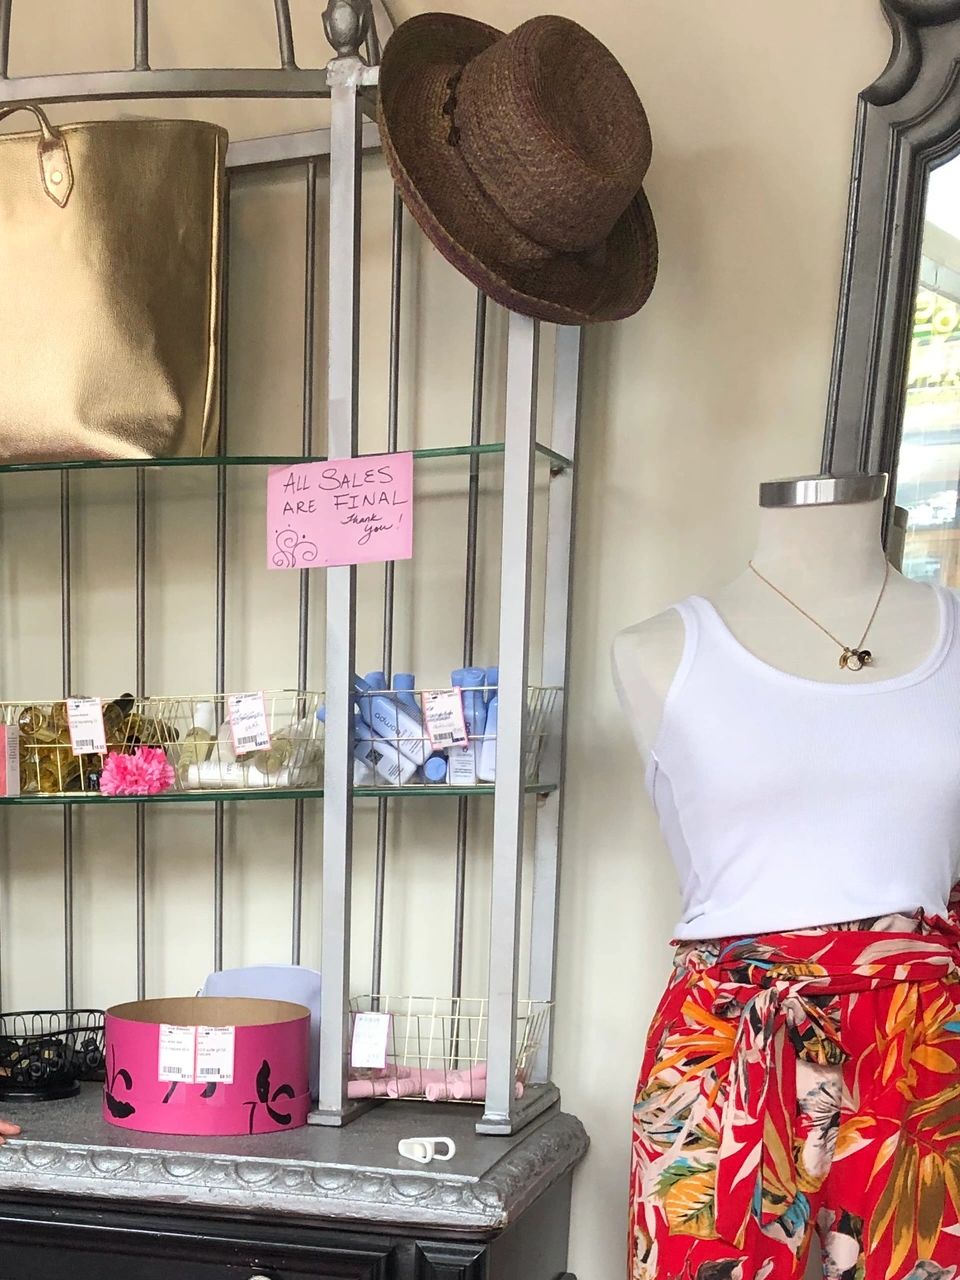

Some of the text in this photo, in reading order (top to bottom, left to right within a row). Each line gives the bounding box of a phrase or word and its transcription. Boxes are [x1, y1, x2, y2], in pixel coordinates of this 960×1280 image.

[283, 466, 394, 494] ALL SALES
[282, 490, 409, 515] ARE FINAL
[341, 513, 383, 525] Thank
